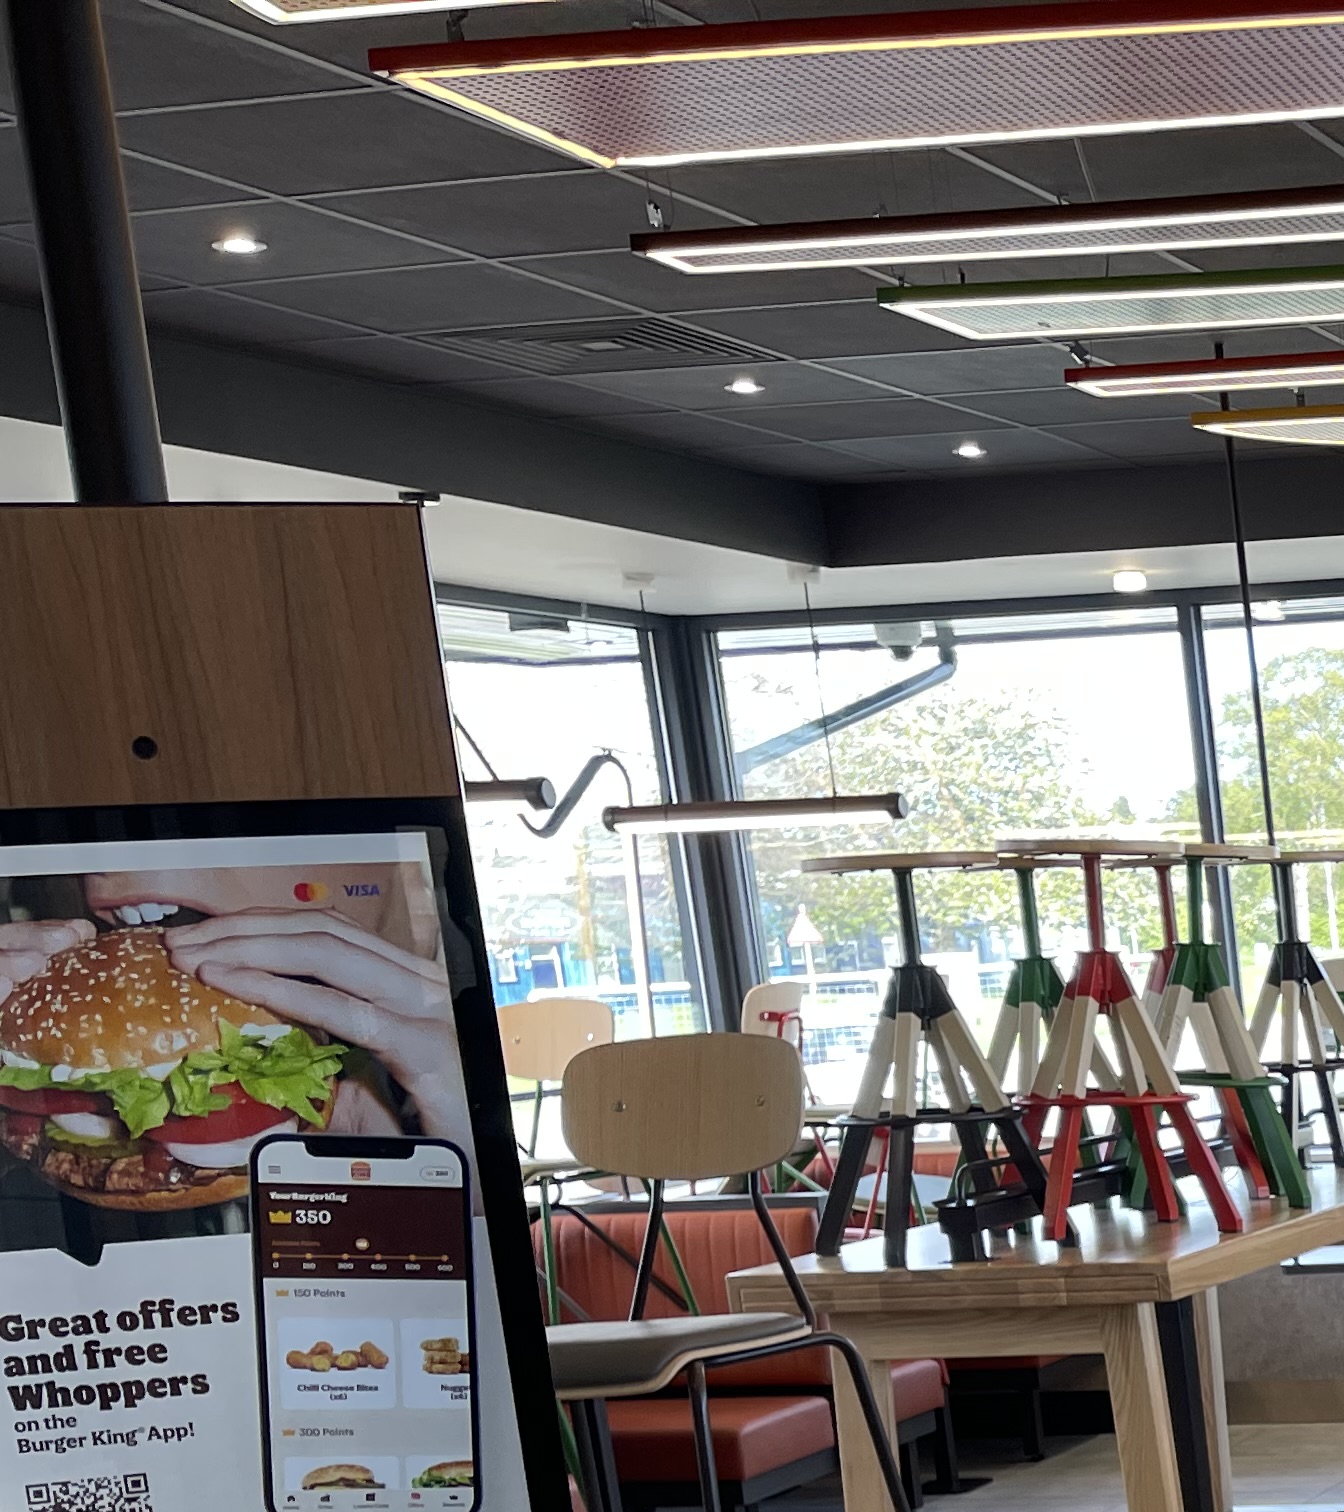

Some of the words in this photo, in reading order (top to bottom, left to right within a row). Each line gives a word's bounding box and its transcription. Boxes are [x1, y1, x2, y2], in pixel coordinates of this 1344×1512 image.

[342, 884, 380, 897] VISA
[295, 1209, 332, 1225] 350
[294, 1288, 311, 1298] 150
[313, 1288, 346, 1298] Points
[0, 1309, 111, 1342] Great
[116, 1298, 241, 1332] offers
[3, 1343, 79, 1378] and
[83, 1339, 169, 1370] free
[7, 1373, 211, 1411] Whoppers
[321, 1384, 354, 1392] Cheese
[14, 1418, 40, 1433] on
[44, 1414, 77, 1431] the
[16, 1434, 87, 1455] Burger
[146, 1421, 196, 1444] App!
[298, 1428, 320, 1437] 300
[322, 1428, 355, 1437] Points
